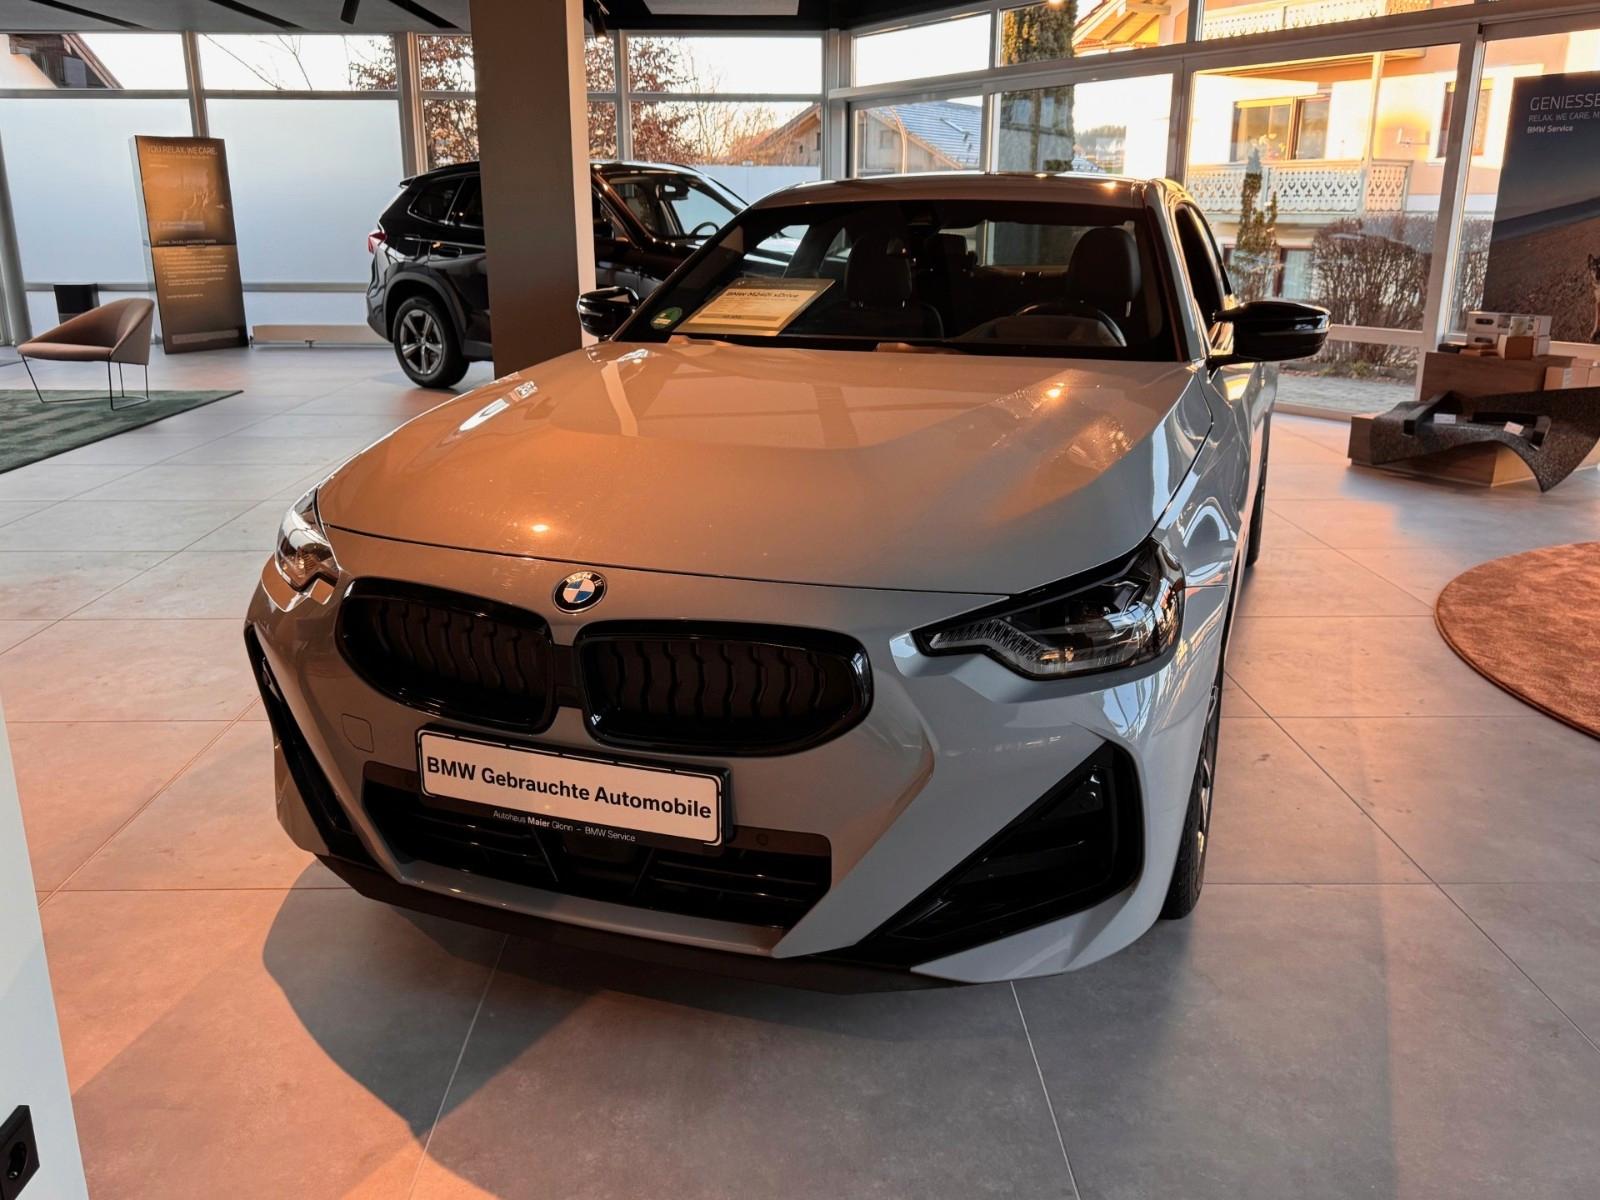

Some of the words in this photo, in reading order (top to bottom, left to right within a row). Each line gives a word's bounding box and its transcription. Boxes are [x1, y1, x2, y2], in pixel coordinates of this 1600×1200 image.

[1530, 93, 1600, 111] GENIESSE
[1556, 113, 1568, 121] WE
[1527, 126, 1546, 134] BMW
[1547, 125, 1574, 133] Service
[145, 144, 162, 154] YOU
[427, 756, 476, 781] BMW
[482, 767, 590, 800] Gebrauchte
[594, 786, 712, 818] Automobile
[493, 809, 527, 824] Autohaus
[527, 816, 550, 828] Maier
[585, 826, 607, 837] BMW
[607, 829, 636, 842] Service
